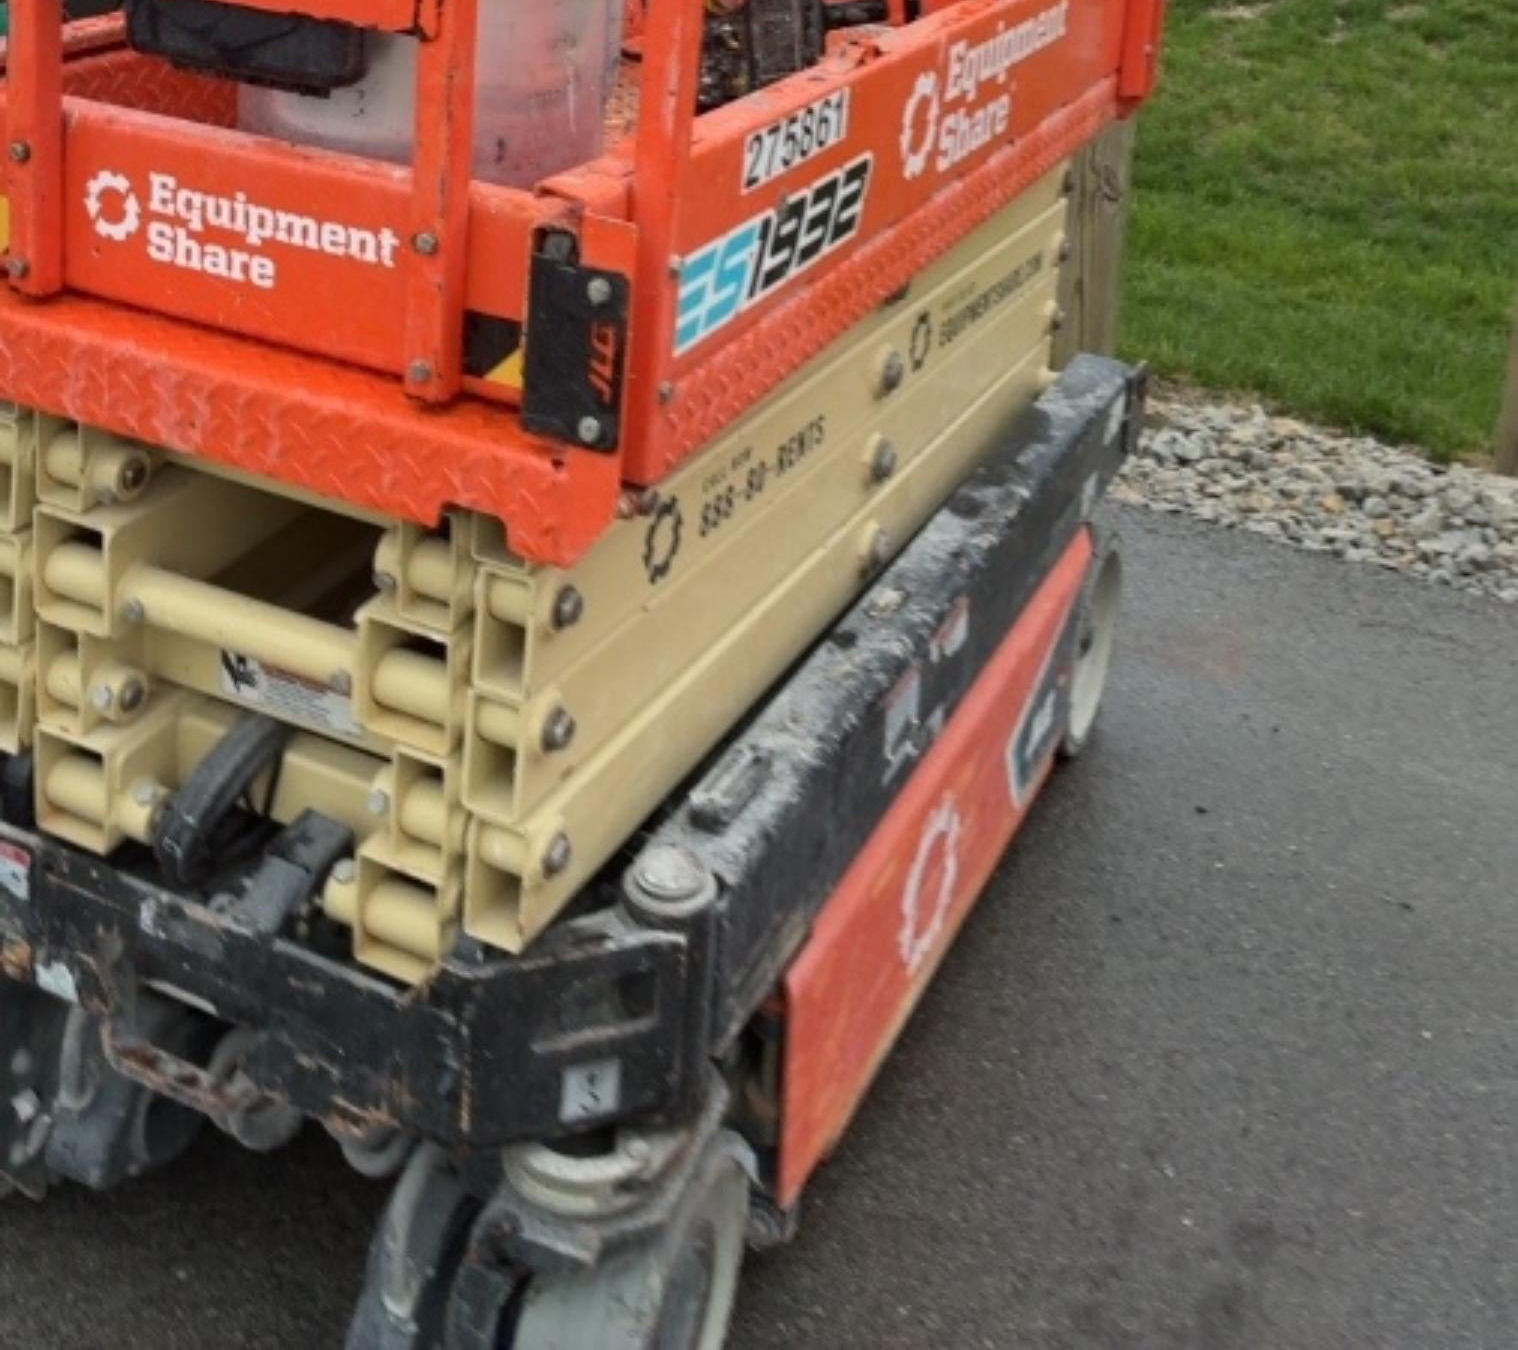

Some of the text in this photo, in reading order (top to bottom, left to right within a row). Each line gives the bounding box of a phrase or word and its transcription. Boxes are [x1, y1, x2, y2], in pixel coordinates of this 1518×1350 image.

[745, 90, 846, 188] 275861
[936, 92, 1011, 172] Share
[147, 221, 275, 289] Share
[149, 171, 399, 267] Equipment
[674, 154, 872, 354] ES1932
